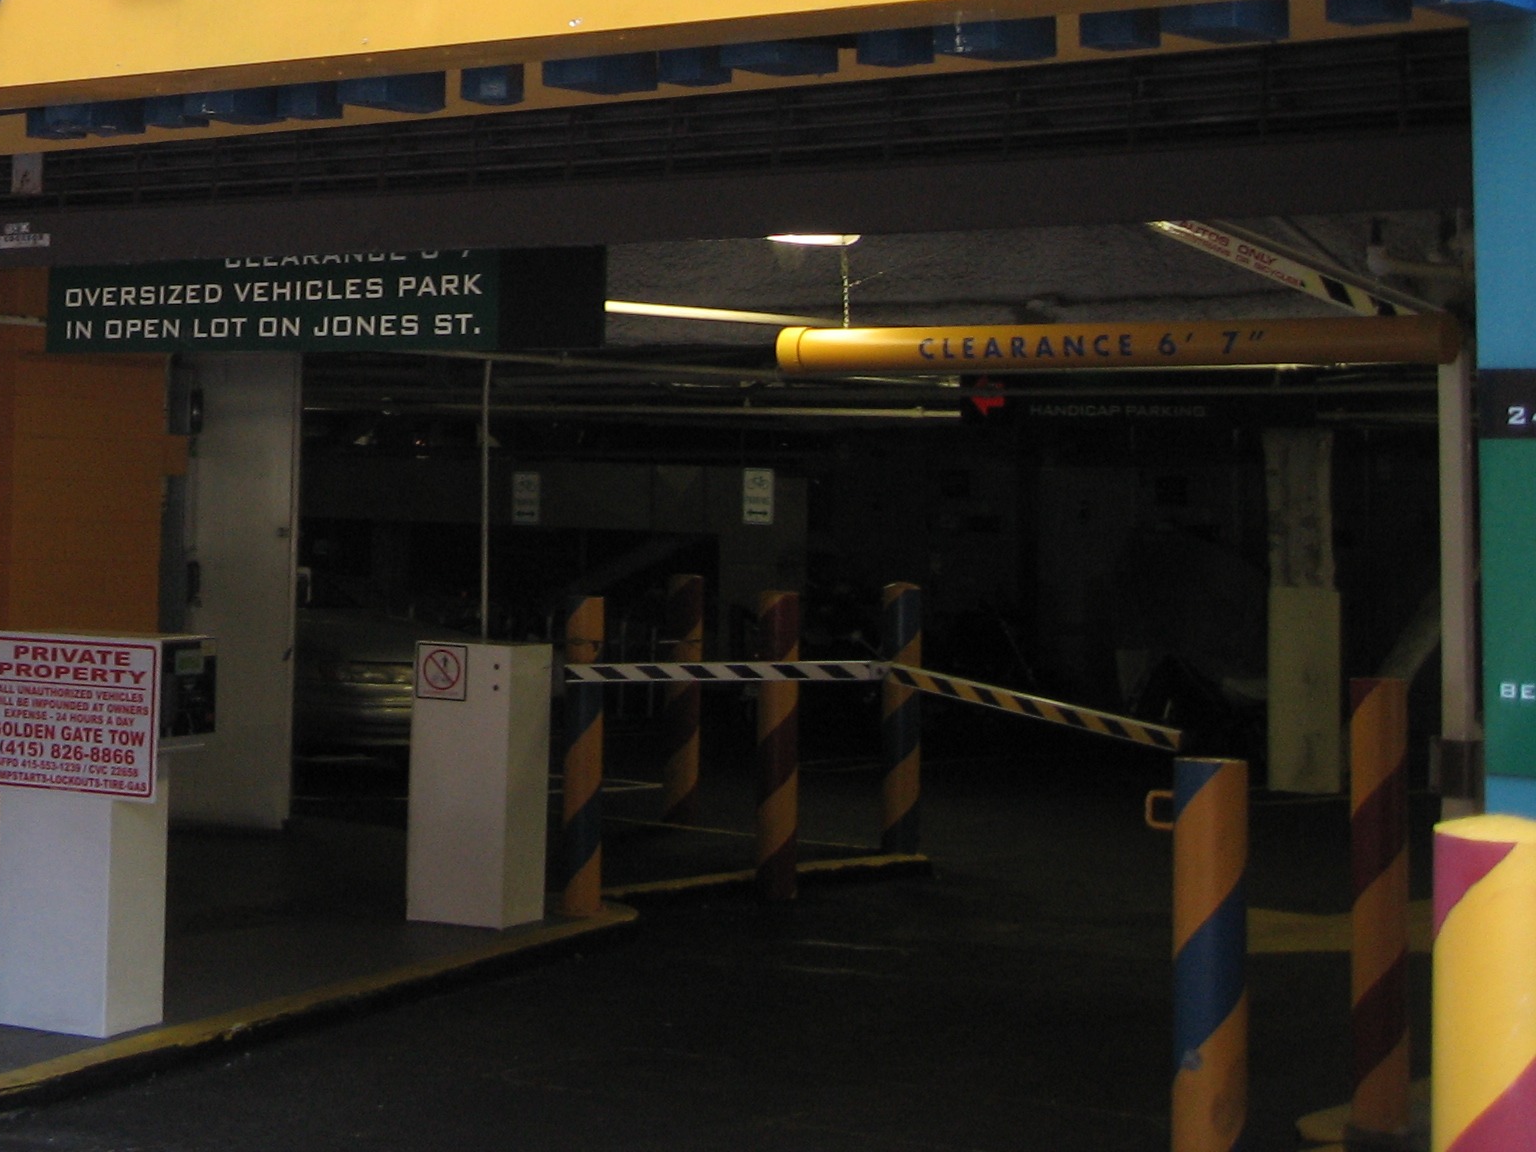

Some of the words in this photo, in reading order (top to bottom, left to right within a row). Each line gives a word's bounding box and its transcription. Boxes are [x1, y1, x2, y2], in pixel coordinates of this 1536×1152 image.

[1237, 244, 1277, 266] ONLY
[65, 284, 223, 307] OVERSIZED
[233, 277, 383, 303] VEHICLES
[398, 273, 483, 297] PARK
[66, 320, 93, 340] IN
[104, 318, 181, 339] OPEN
[194, 317, 248, 338] LOT
[259, 316, 300, 338] ON
[313, 315, 419, 337] JONES
[434, 313, 481, 336] ST.
[919, 333, 1134, 361] CLEARANCE
[1030, 405, 1122, 417] HANDICAP
[1125, 405, 1207, 418] PARKING
[14, 645, 131, 666] PRIVATE
[18, 685, 92, 699] UNAUTHORIZED
[96, 691, 143, 702] VEHICLES
[4, 709, 47, 720] EXPENSE
[56, 712, 67, 721] 24
[70, 714, 103, 725] HOURS
[106, 716, 113, 724] A
[116, 716, 135, 726] DAY
[16, 698, 29, 707] BE
[32, 699, 89, 711] IMPOUNDED
[92, 703, 104, 711] AT
[107, 704, 149, 716] OWNERS
[61, 726, 103, 743] GATE
[109, 730, 145, 747] TOW
[0, 740, 44, 757] (415)
[51, 744, 135, 764] 826-8866
